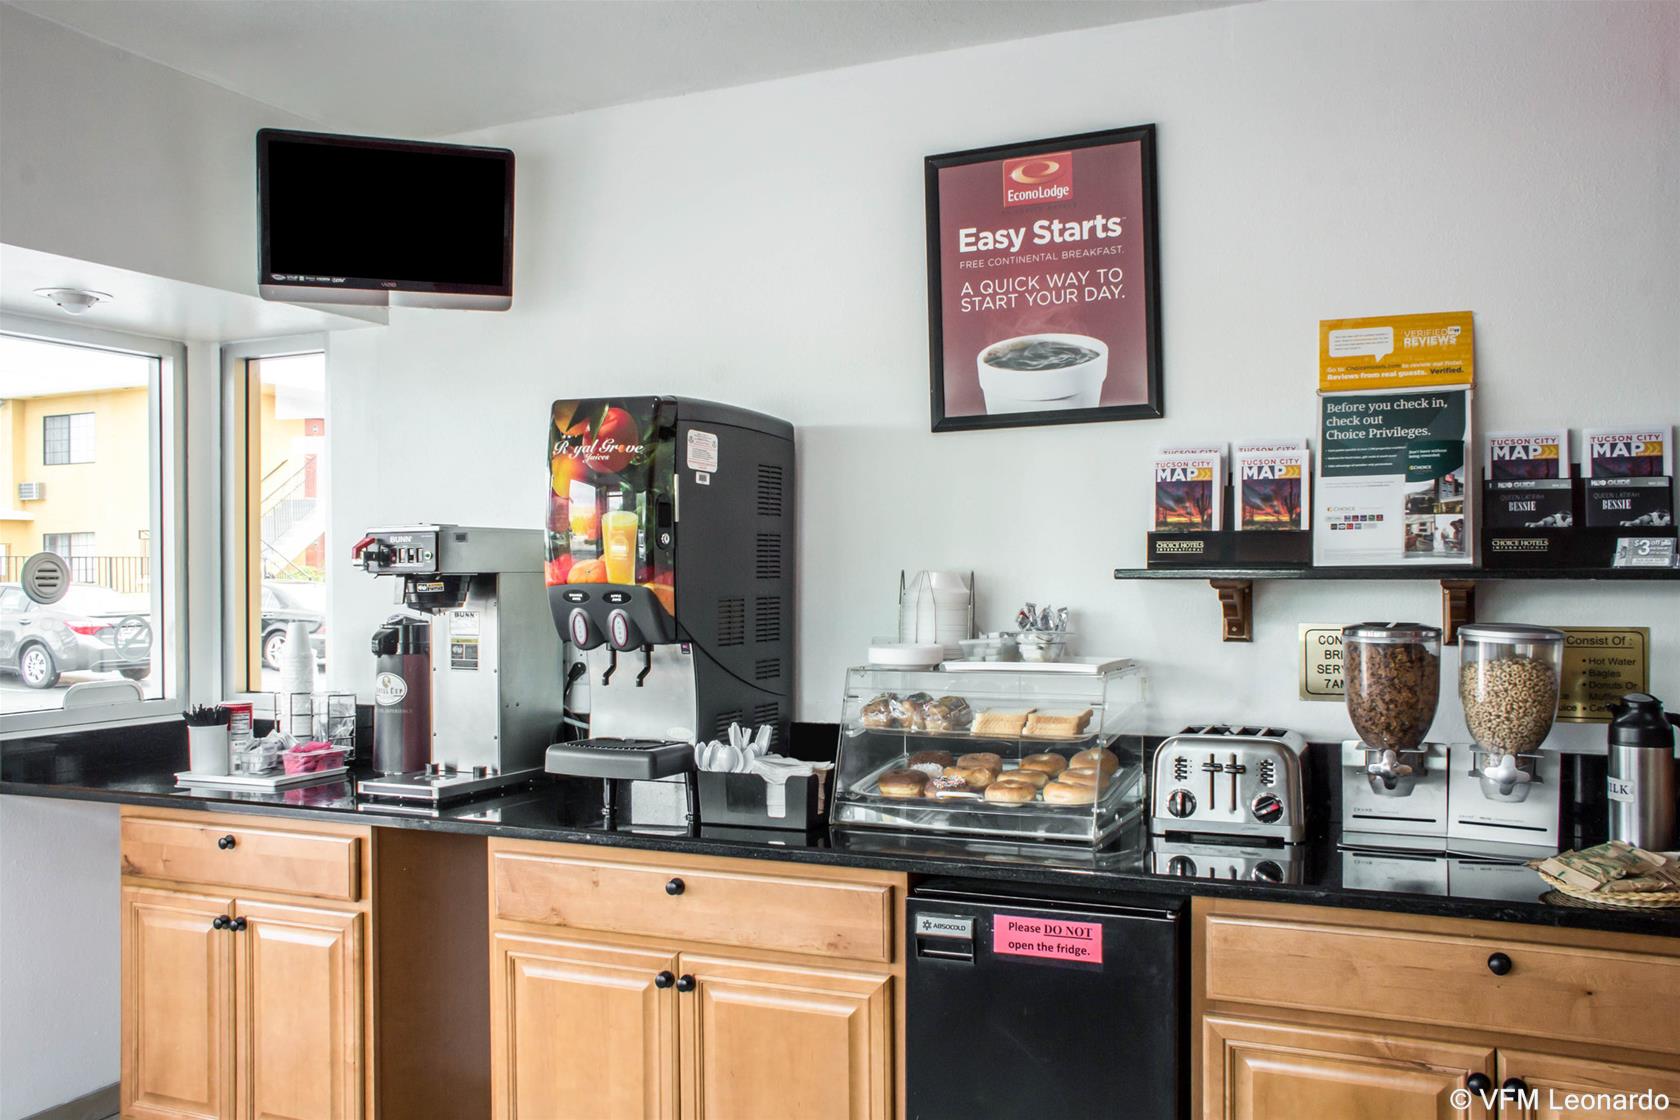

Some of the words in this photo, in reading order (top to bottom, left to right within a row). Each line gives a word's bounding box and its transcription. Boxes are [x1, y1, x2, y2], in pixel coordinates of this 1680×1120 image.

[1008, 185, 1070, 202] EconoLodge
[959, 227, 1026, 253] Easy
[960, 260, 985, 269] FREE
[988, 252, 1058, 267] CONTINENTAL
[1062, 245, 1125, 260] BREAKFAST.
[961, 282, 973, 296] A
[980, 275, 1040, 295] QUICK
[1046, 270, 1090, 288] WAY
[1097, 267, 1123, 283] TO
[961, 293, 1018, 313] START
[1025, 290, 1078, 307] YOUR
[1085, 284, 1126, 302] DAY.
[1404, 328, 1448, 337] VERIFIED
[1404, 335, 1457, 347] REVIEWS
[1360, 371, 1380, 379] from
[1398, 369, 1428, 379] guests.
[1430, 366, 1465, 375] Verified.
[1327, 402, 1365, 413] Before
[1368, 402, 1391, 414] you
[1394, 398, 1429, 410] check
[1432, 397, 1448, 409] in,
[1326, 415, 1361, 426] check
[1363, 415, 1383, 425] out
[1326, 428, 1366, 440] Choice
[1368, 426, 1432, 439] Privileges.
[1493, 445, 1542, 460] MAP
[1593, 442, 1645, 459] MAP
[1157, 467, 1199, 482] MAP
[1243, 465, 1286, 480] MAP
[1508, 501, 1536, 511] BESSIE
[1602, 499, 1631, 510] BESSIE
[1318, 635, 1343, 646] CON
[1566, 635, 1608, 646] Consist
[1588, 657, 1604, 665] Hot
[1608, 657, 1636, 666] Water
[1625, 681, 1638, 690] Or
[1609, 782, 1630, 795] ILK
[933, 922, 966, 932] ABSOCOLD
[1008, 921, 1041, 934] Please
[1044, 924, 1062, 935] DO
[1066, 926, 1093, 938] NOT
[1008, 940, 1034, 951] open
[1037, 940, 1054, 952] the
[1057, 943, 1090, 957] fridge.
